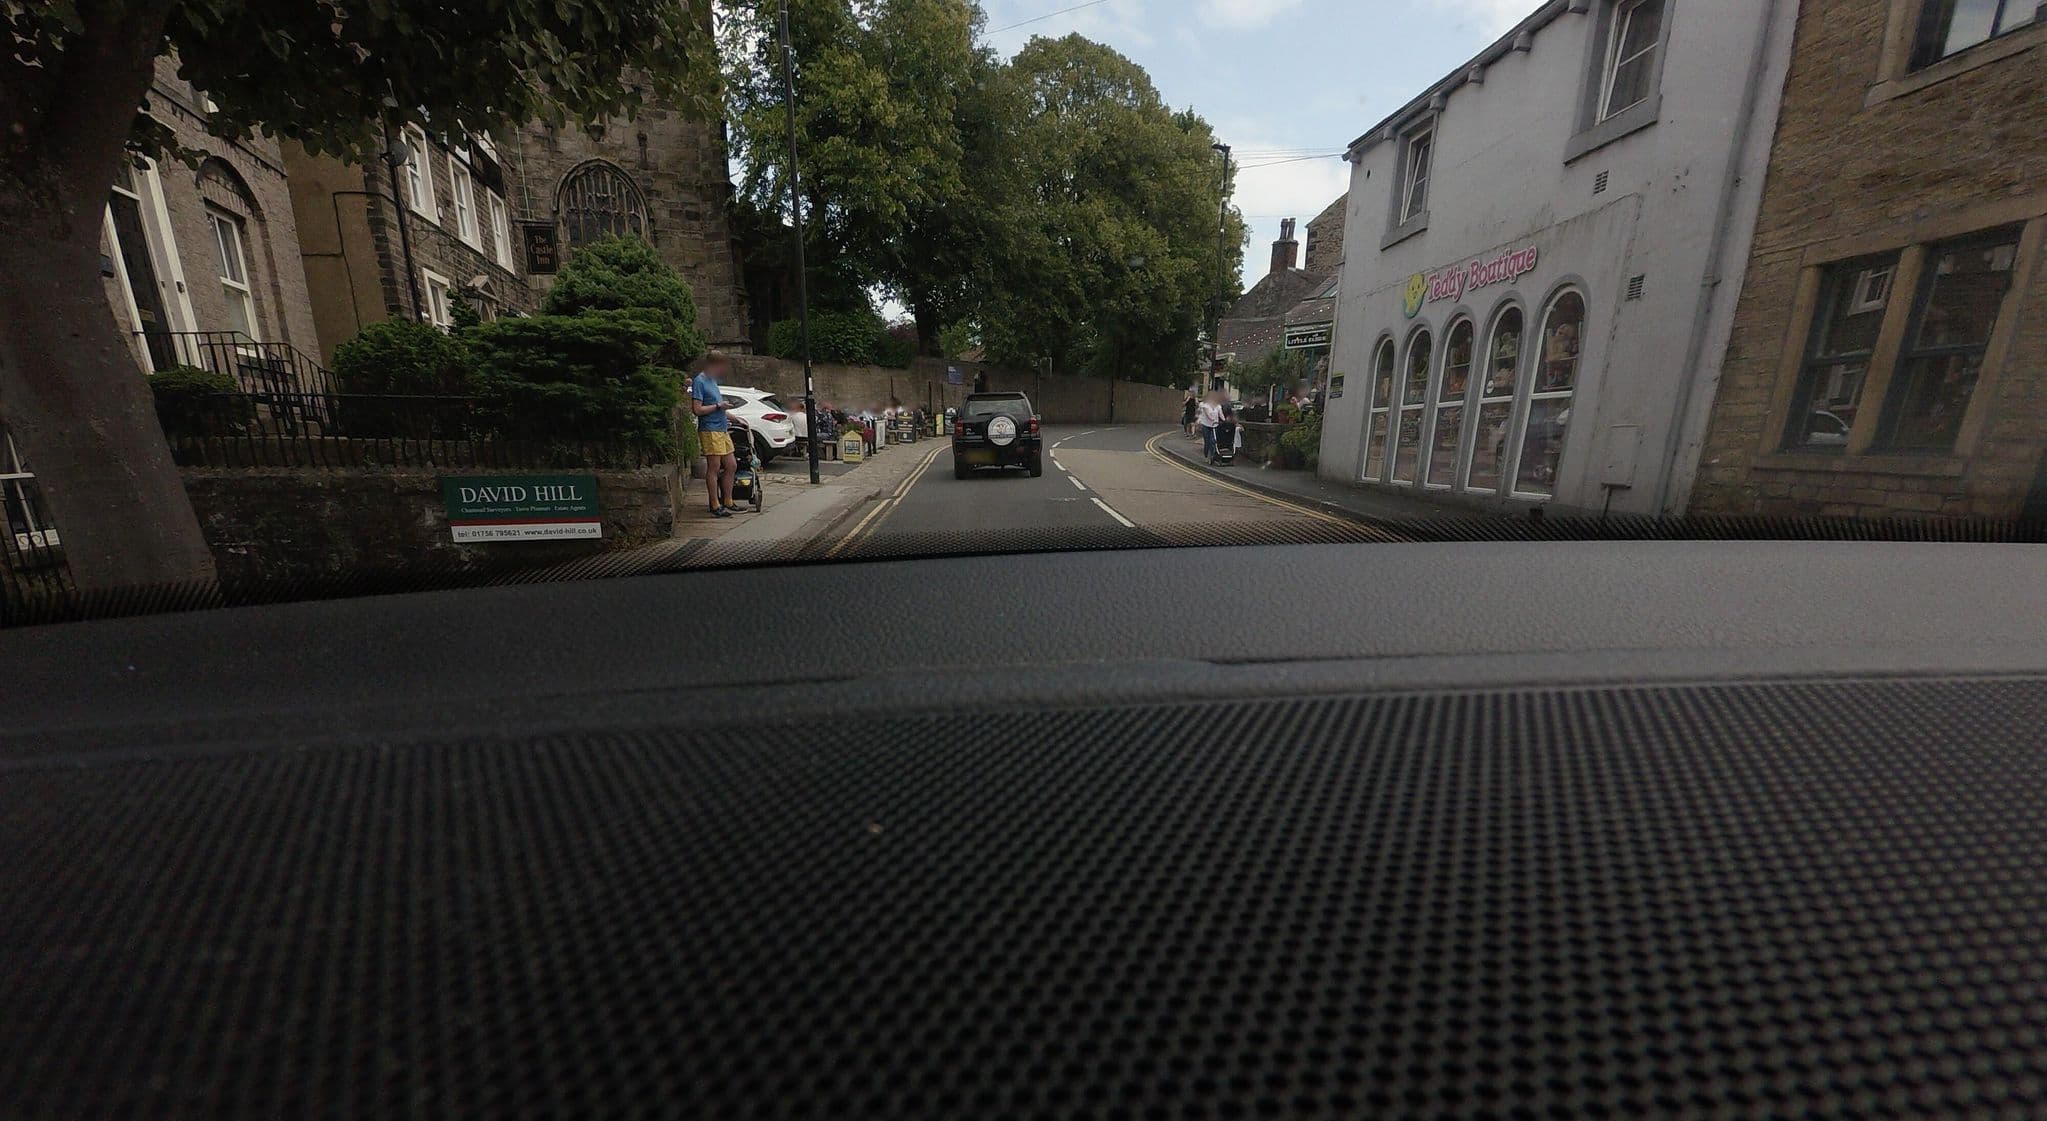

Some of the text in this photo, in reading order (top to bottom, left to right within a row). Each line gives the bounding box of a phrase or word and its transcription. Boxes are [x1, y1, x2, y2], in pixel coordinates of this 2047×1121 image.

[534, 234, 546, 244] The
[530, 244, 554, 256] Castle
[536, 255, 550, 265] Inn
[1428, 246, 1537, 302] Teddy Boutique
[459, 485, 582, 503] DAVID HILL
[524, 527, 597, 536] www.david-hill.co.uk
